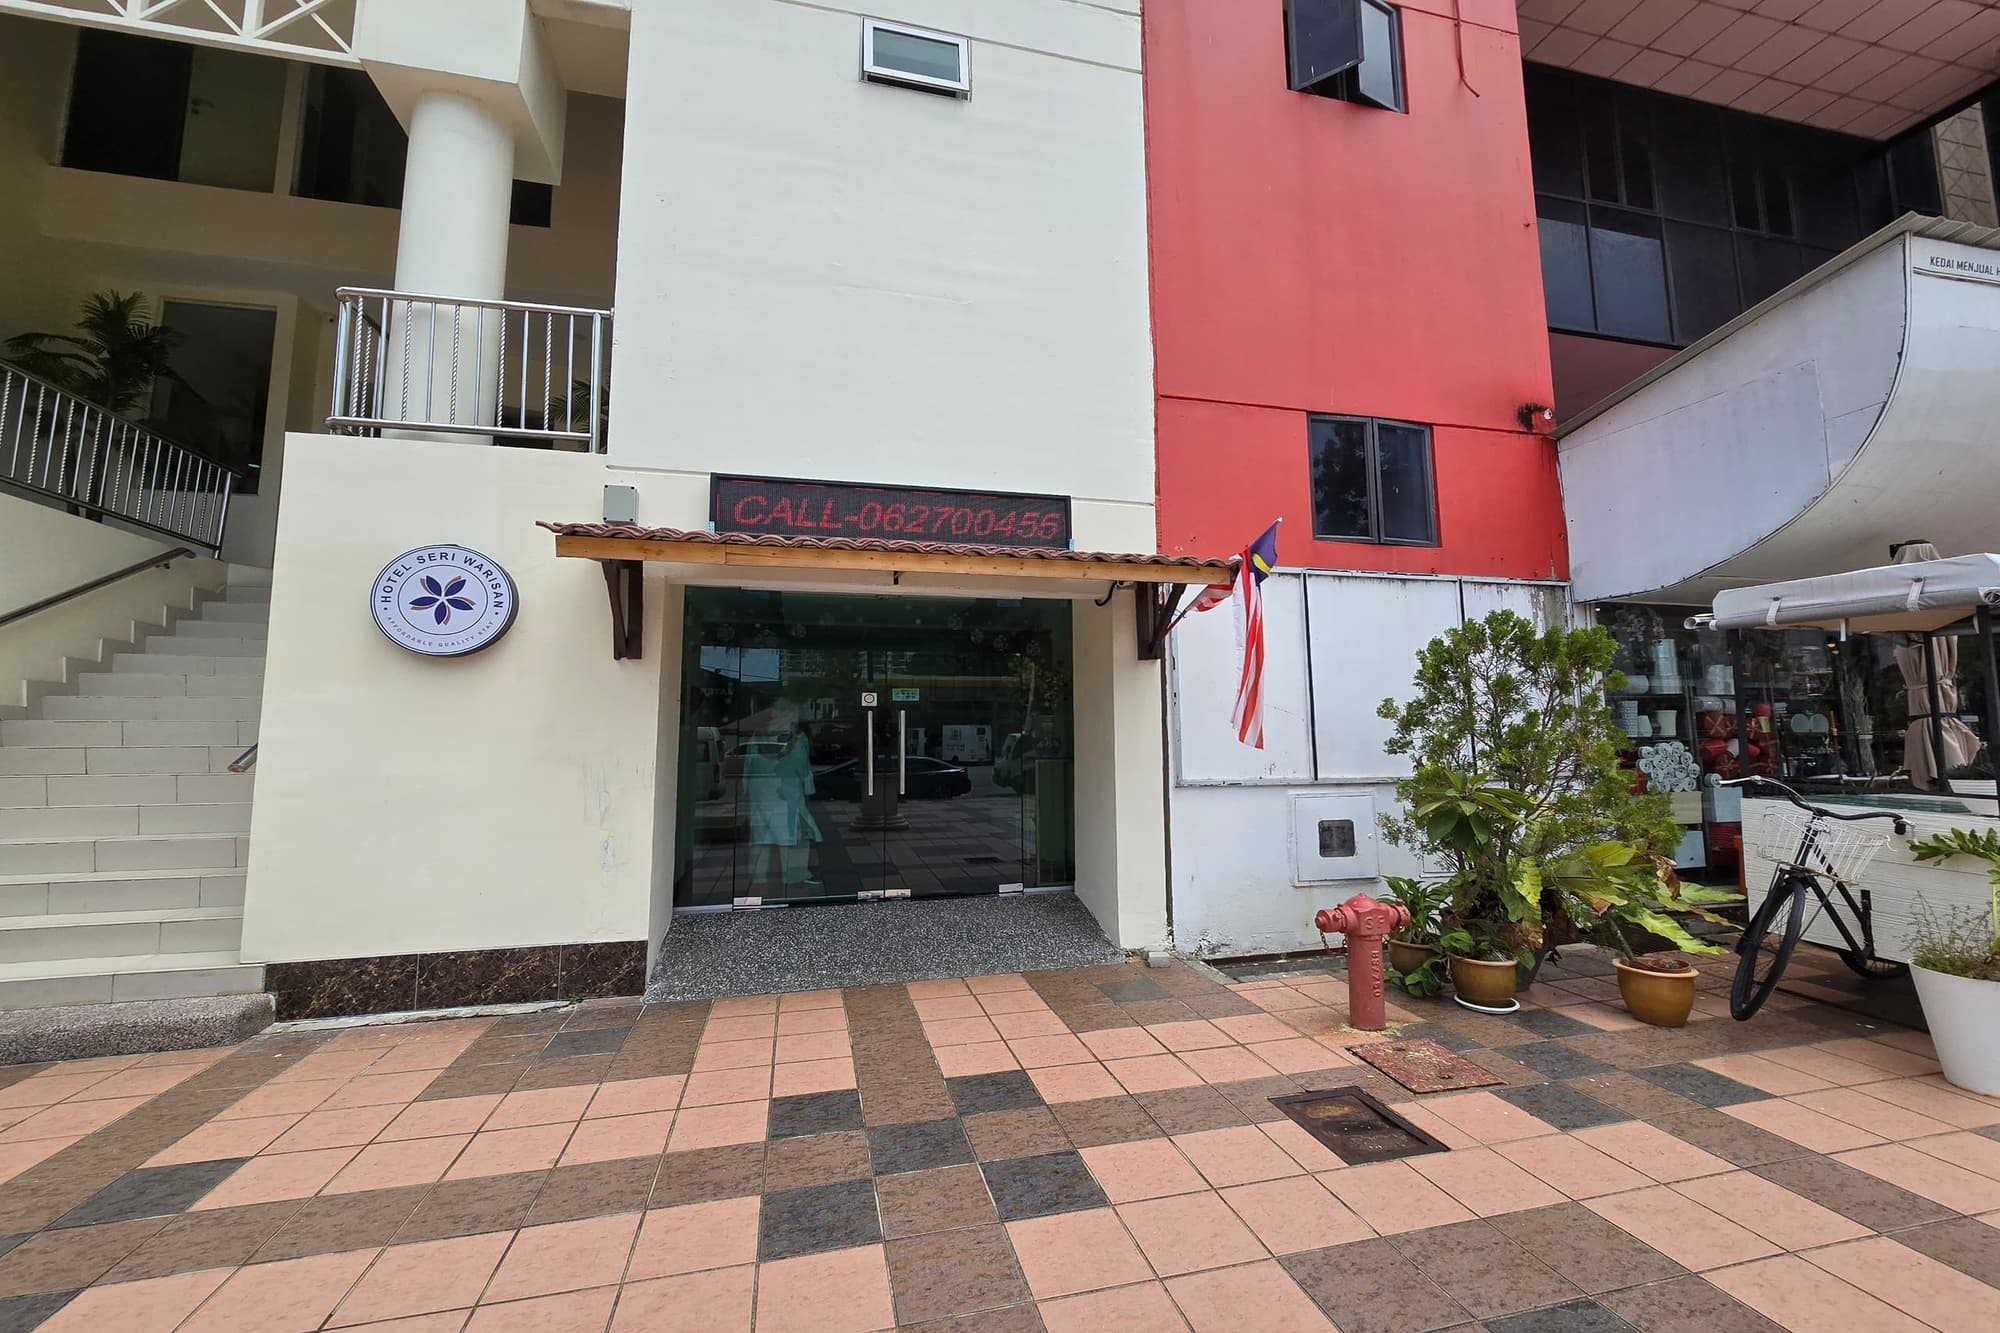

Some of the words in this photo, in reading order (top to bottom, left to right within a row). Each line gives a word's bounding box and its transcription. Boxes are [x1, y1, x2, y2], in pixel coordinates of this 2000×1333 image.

[1930, 256, 1954, 269] KEDAI
[1957, 261, 1993, 275] MENJUAL
[380, 563, 413, 604] HOTEL
[416, 551, 456, 565] SERI
[463, 555, 504, 609] WARISAN
[387, 616, 433, 647] AFFORDABLE
[437, 636, 475, 648] QUALITY
[477, 621, 494, 636] STAY
